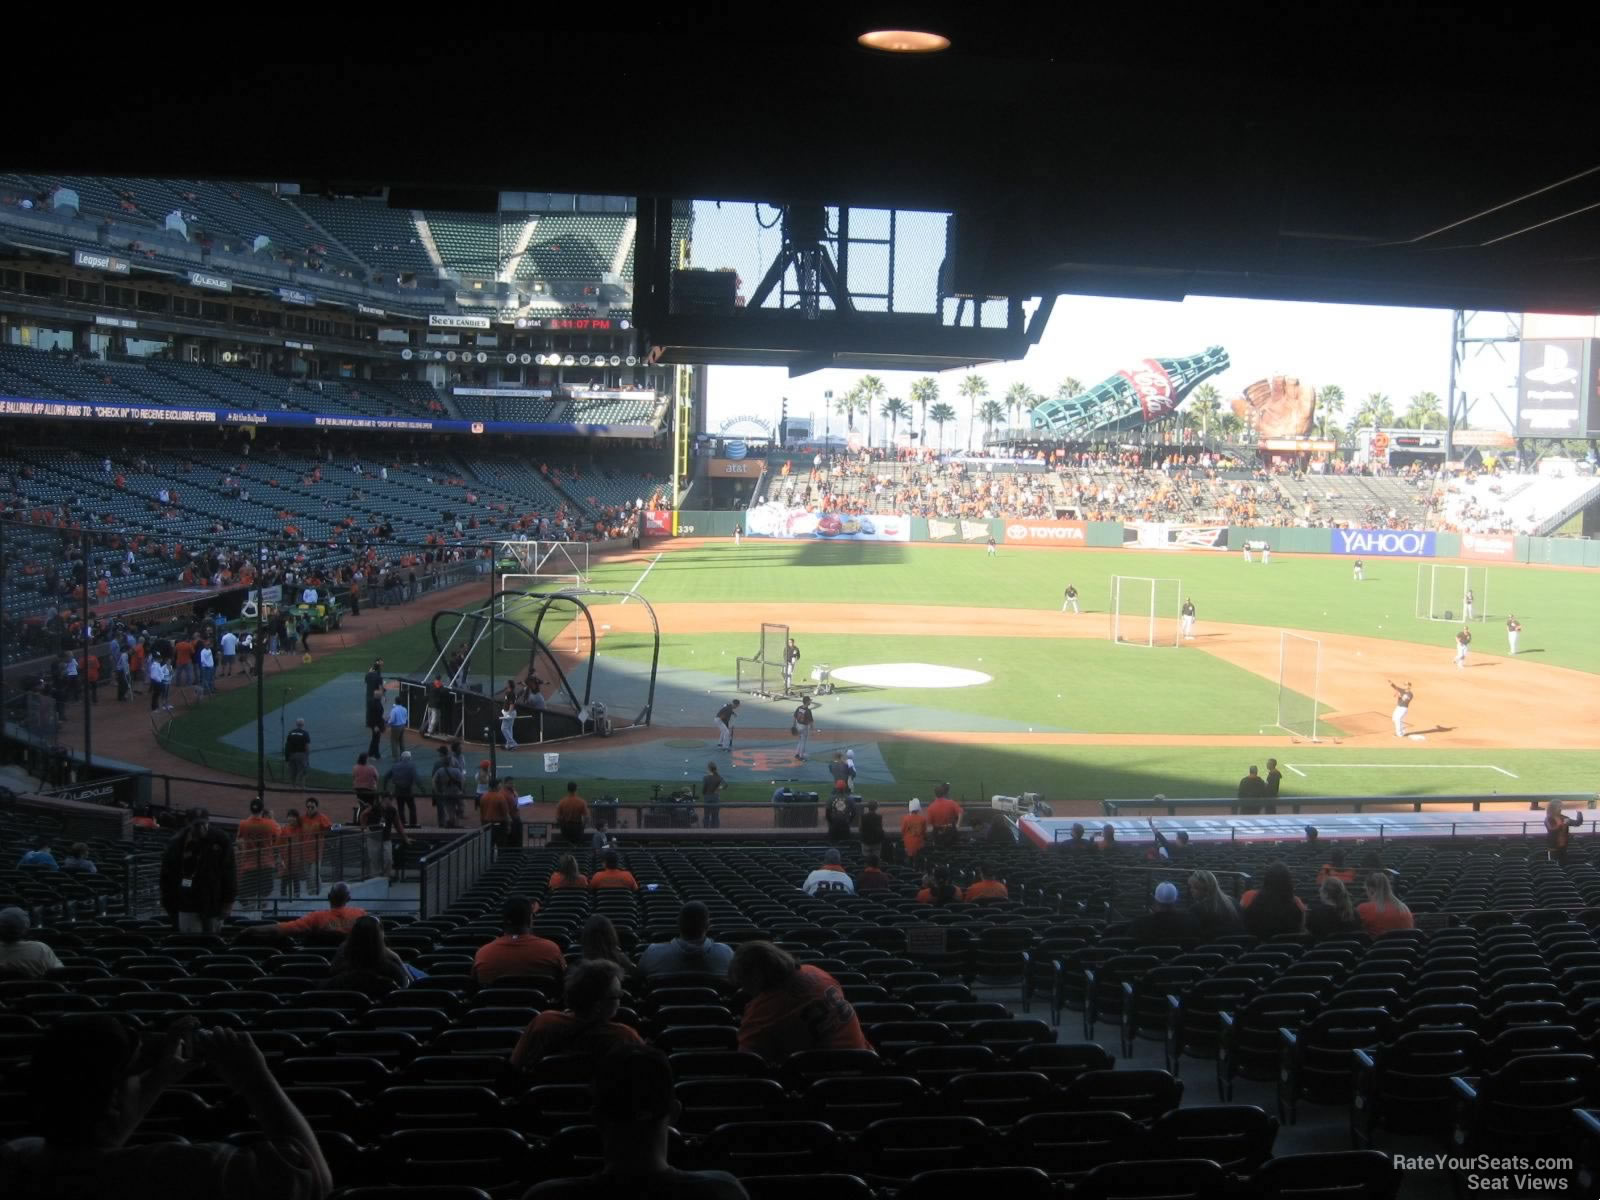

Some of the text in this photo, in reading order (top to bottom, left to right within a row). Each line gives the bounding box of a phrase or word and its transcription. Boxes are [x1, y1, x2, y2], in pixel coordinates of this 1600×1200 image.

[202, 277, 228, 288] LEXUS
[592, 319, 610, 329] PM
[6, 401, 33, 413] BALLPARK
[33, 402, 45, 414] APP
[44, 403, 65, 416] ALLOWS
[66, 405, 81, 416] FANS
[82, 405, 93, 416] TO:
[131, 408, 140, 419] TO
[140, 409, 164, 420] RECEIVE
[165, 410, 195, 420] EXCLUSIVE
[195, 411, 216, 421] OFFERS
[678, 525, 694, 533] 339
[1030, 527, 1083, 539] TOYOTA
[1340, 531, 1426, 555] YAHOO!
[73, 786, 113, 800] LEXUS
